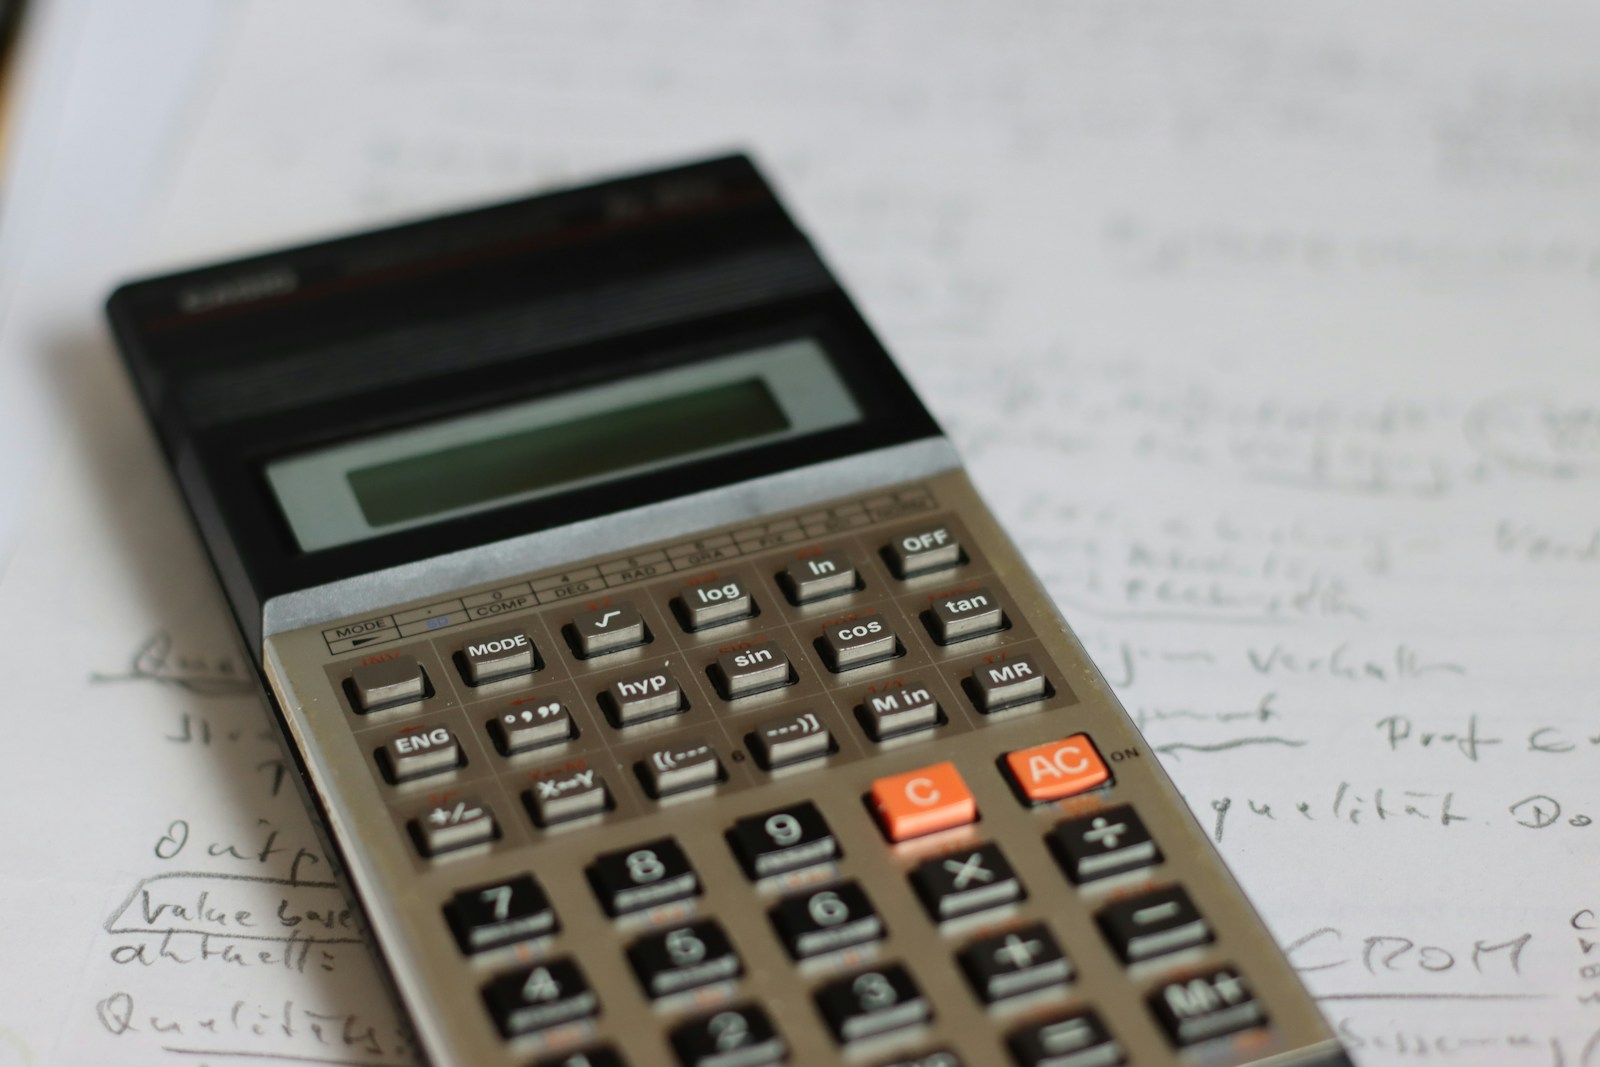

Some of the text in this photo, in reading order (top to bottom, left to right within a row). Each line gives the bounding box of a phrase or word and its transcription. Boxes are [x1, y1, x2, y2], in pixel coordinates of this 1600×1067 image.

[903, 529, 948, 551] OFF
[621, 566, 657, 582] RAD
[555, 582, 590, 598] DEG
[697, 582, 740, 603] log
[477, 597, 528, 617] COMP
[945, 595, 988, 614] tan
[336, 618, 386, 639] MODE
[838, 620, 882, 641] cos
[468, 634, 528, 657] MODE
[734, 649, 773, 667] sin
[988, 661, 1033, 684] MR
[617, 674, 667, 697] hyp
[394, 728, 450, 753] ENG
[1028, 746, 1090, 784] AC
[1111, 748, 1140, 763] ON
[904, 776, 941, 807] C
[764, 813, 803, 847] 9
[626, 848, 666, 884] 8
[480, 885, 514, 920] 7
[807, 889, 850, 927] 6
[665, 926, 707, 967] 5
[522, 965, 561, 1002] 4
[852, 971, 898, 1013] 3
[1164, 970, 1246, 1019] M+
[706, 1010, 752, 1051] 2
